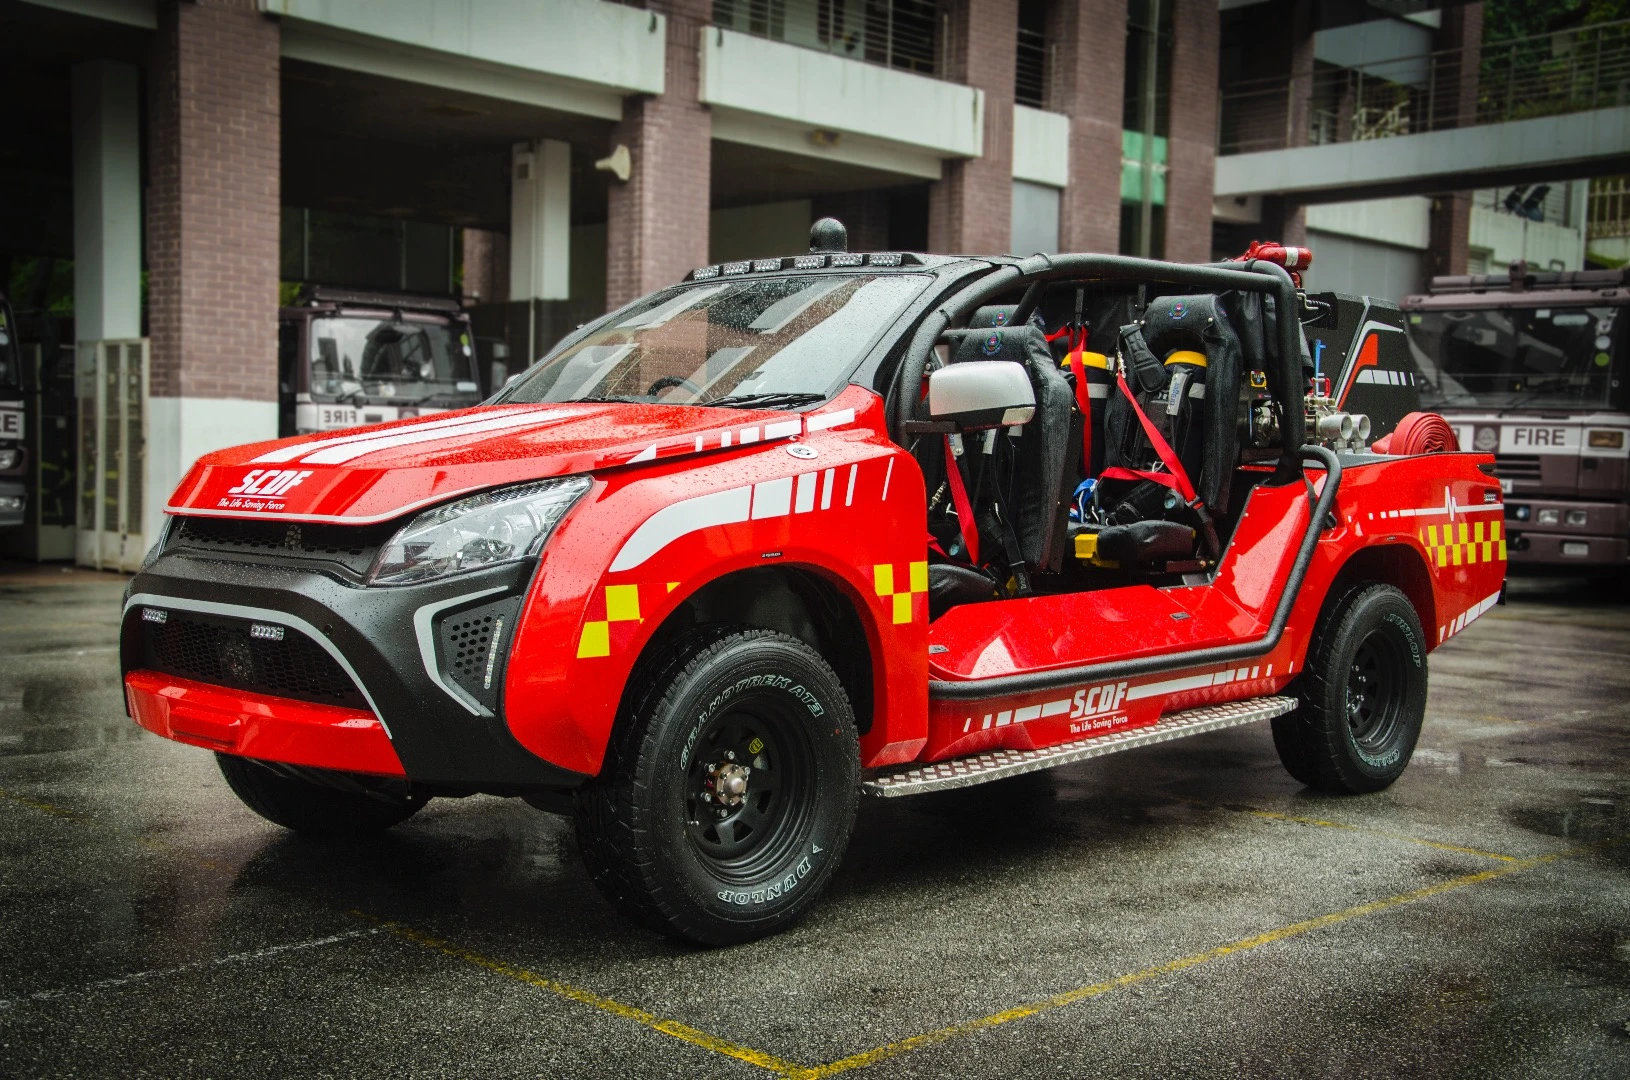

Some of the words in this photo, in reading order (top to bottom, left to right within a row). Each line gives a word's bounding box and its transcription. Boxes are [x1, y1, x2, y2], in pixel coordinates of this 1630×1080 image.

[1514, 428, 1566, 446] FIRE
[227, 469, 314, 495] SCDF
[217, 498, 229, 507] The
[229, 498, 242, 507] Life
[242, 499, 265, 511] Saving
[265, 500, 285, 509] Force
[1386, 613, 1421, 668] DUNLOP
[1070, 682, 1127, 718] SCDF
[1070, 724, 1080, 733] The
[1082, 721, 1091, 731] Life
[1093, 718, 1111, 728] Saving
[1113, 716, 1127, 724] Force
[717, 855, 812, 905] DUNLOP
